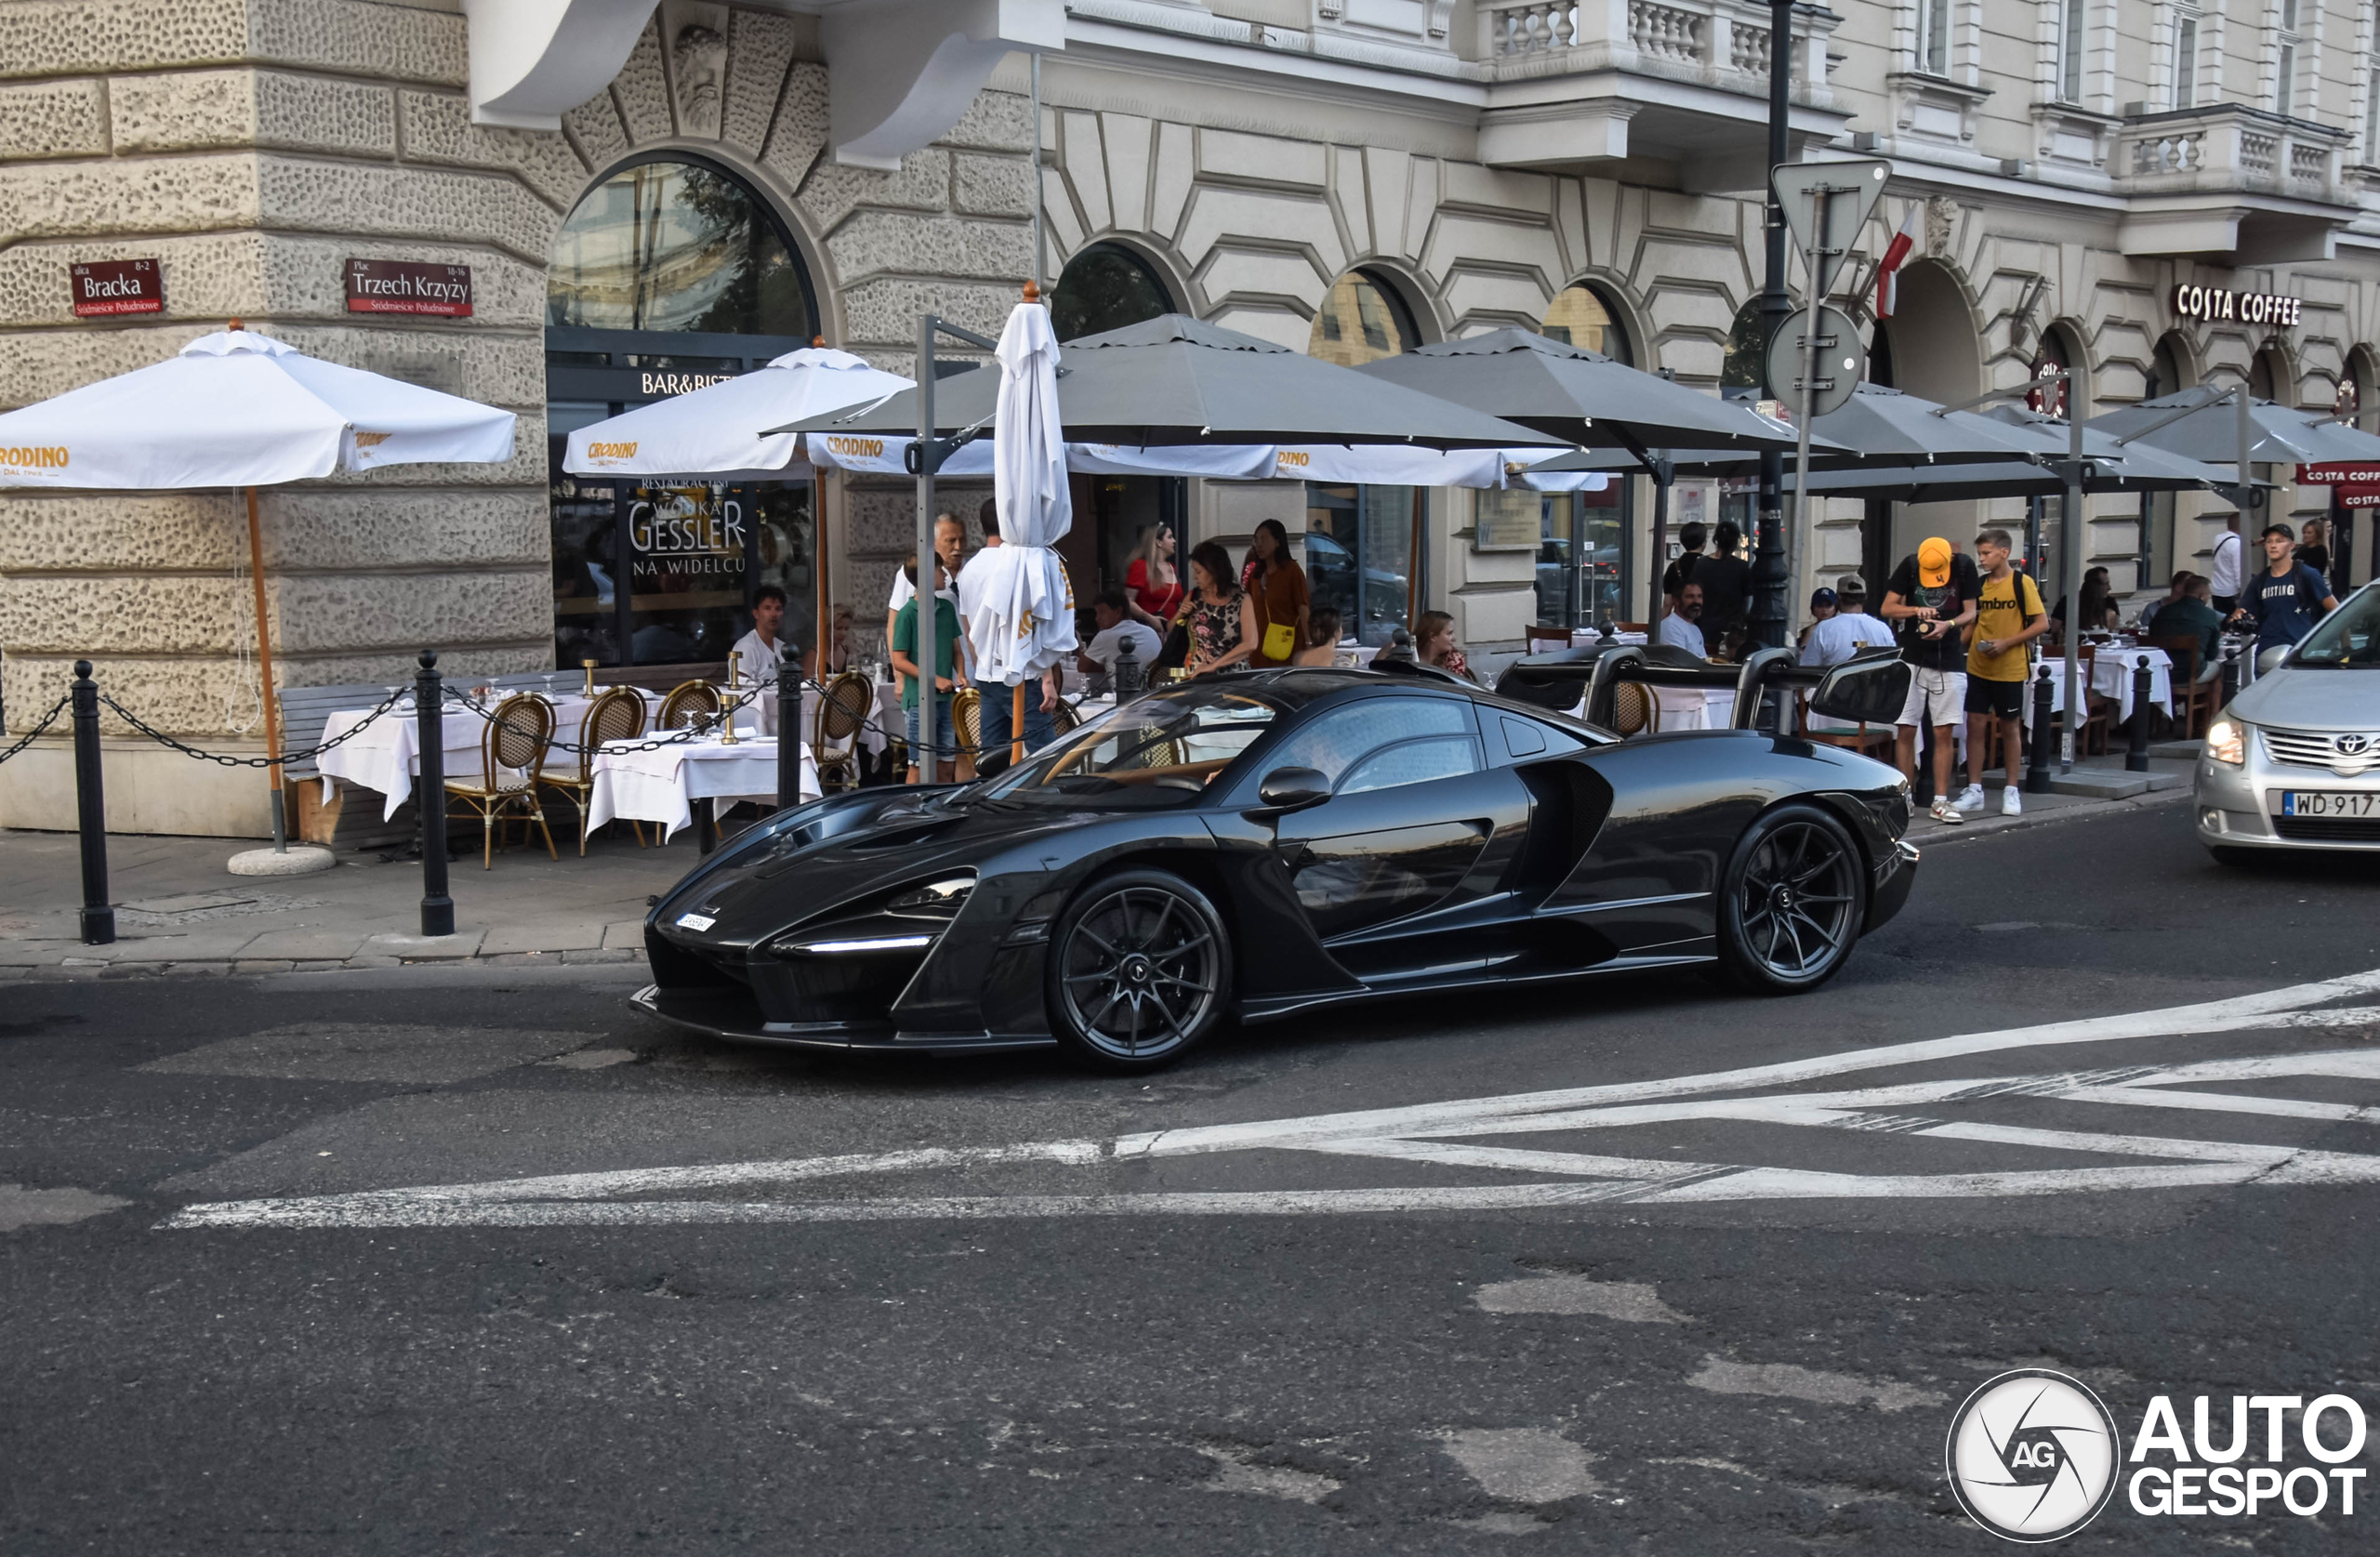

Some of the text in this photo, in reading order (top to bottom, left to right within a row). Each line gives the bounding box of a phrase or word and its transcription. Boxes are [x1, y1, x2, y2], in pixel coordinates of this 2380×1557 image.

[74, 261, 150, 275] ulica 8-2
[353, 261, 369, 270] Plac
[84, 273, 142, 297] Bracka
[353, 273, 468, 304] Trzech Krzyży
[76, 300, 159, 315] Śródmieście Południowe
[371, 300, 456, 314] Śródmieście Południowe
[2177, 284, 2301, 325] COSTA COFFEE
[588, 442, 638, 458] CRODINO
[827, 436, 884, 458] CRODINO
[2307, 471, 2380, 482] COSTA COFF
[2346, 495, 2380, 506] COSTA
[629, 500, 746, 552] GESSLER
[633, 558, 745, 576] NA WIDELCU
[1980, 598, 2016, 610] mbro
[2297, 795, 2380, 816] WD 917
